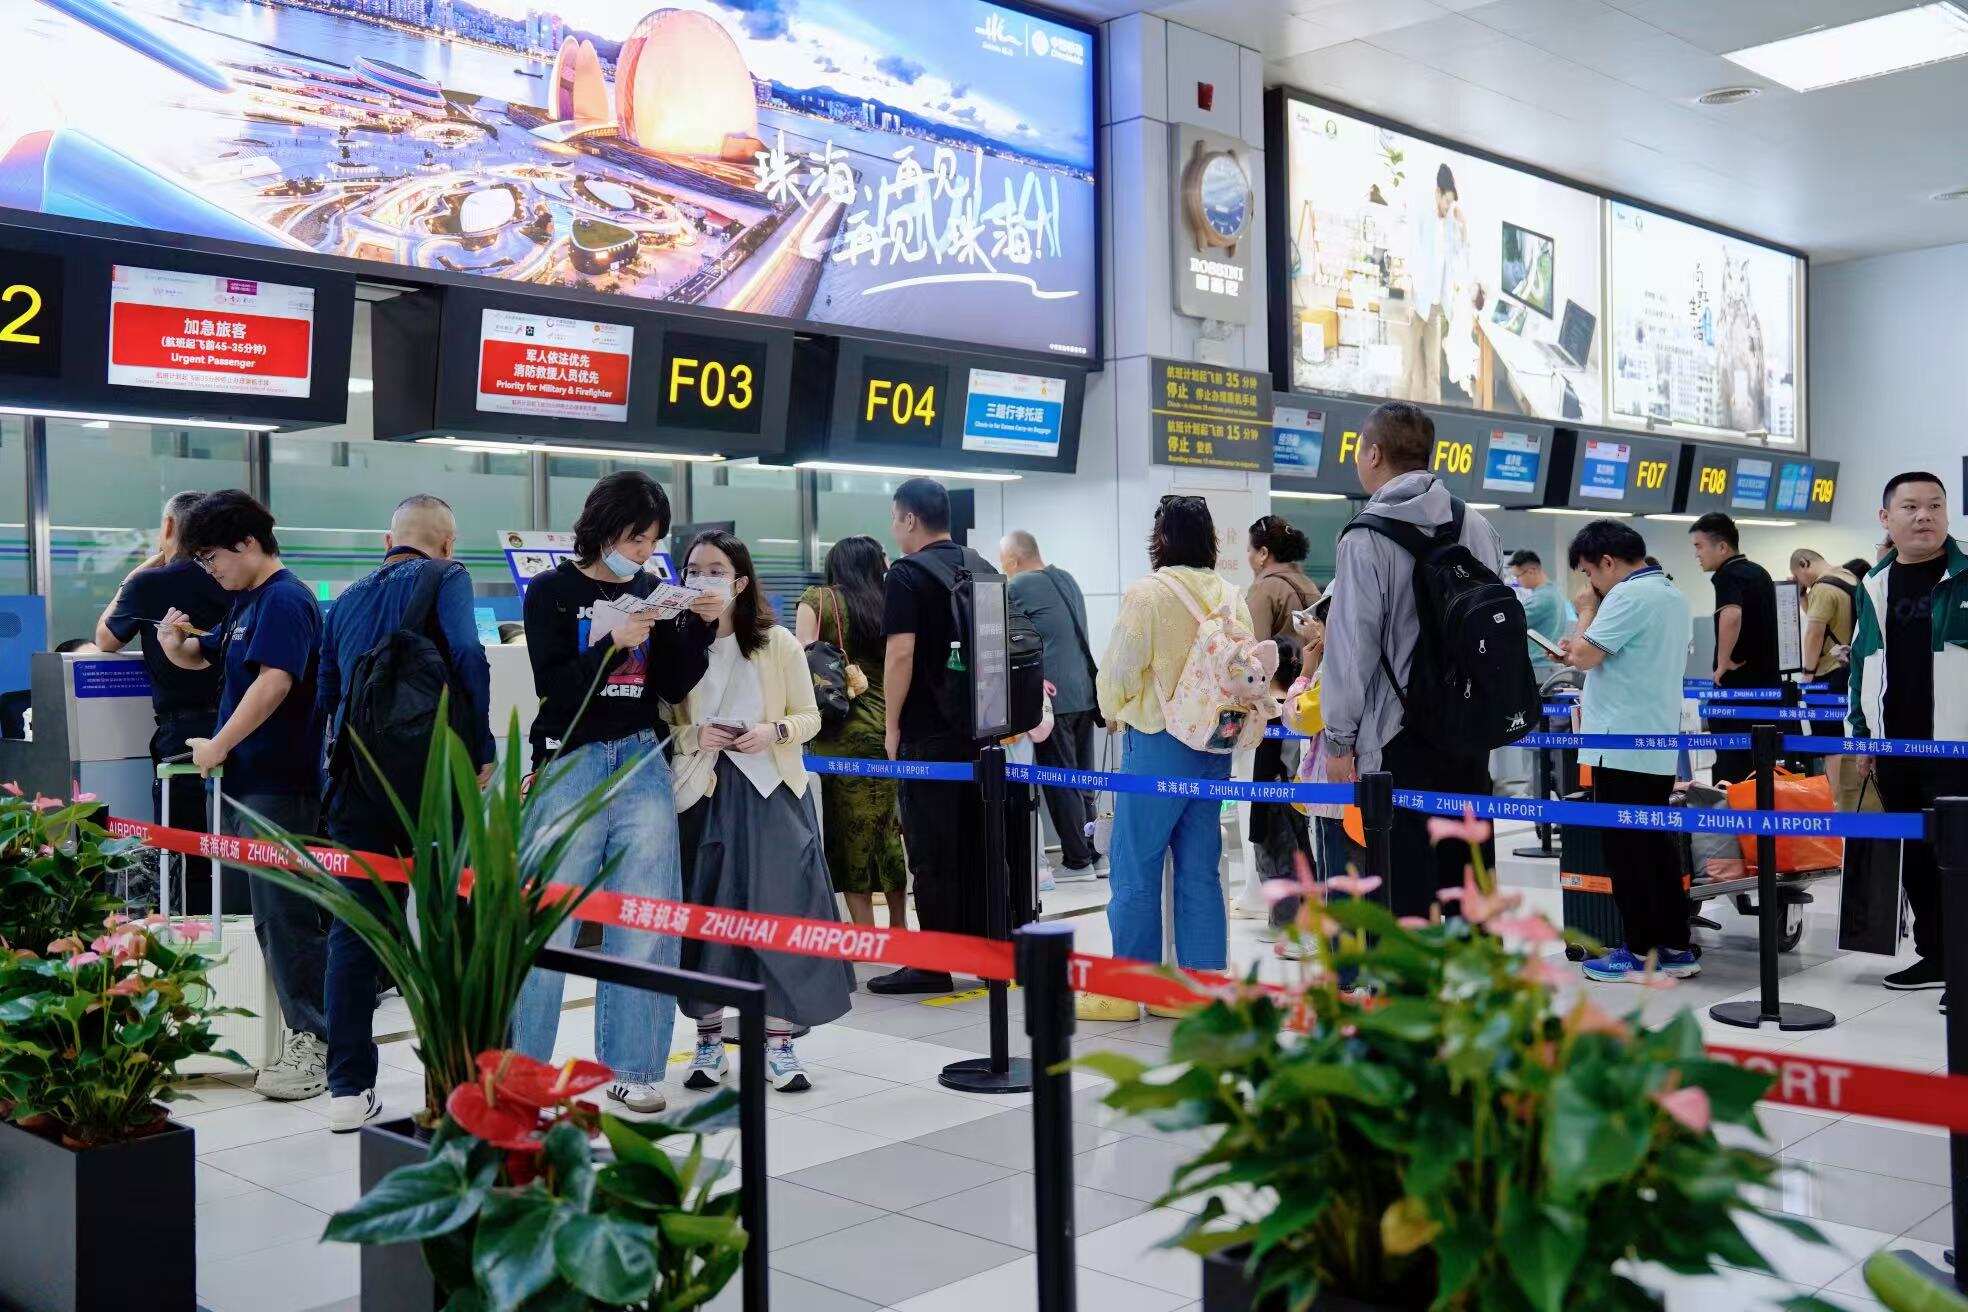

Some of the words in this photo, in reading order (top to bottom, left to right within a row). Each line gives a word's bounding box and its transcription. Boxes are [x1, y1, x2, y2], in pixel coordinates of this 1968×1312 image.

[184, 318, 247, 339] 加急旅客
[171, 352, 205, 366] Urgent
[207, 355, 256, 369] Passenger
[526, 348, 591, 367] 军人依法优先
[514, 363, 600, 384] 消防救援人员优先
[1225, 372, 1240, 388] 35
[496, 380, 525, 392] Priority
[526, 382, 538, 392] for
[539, 383, 567, 396] Military
[568, 386, 575, 395] &
[575, 387, 613, 399] Firefighter
[669, 357, 753, 410] F03
[1167, 381, 1189, 399] 停止
[866, 379, 936, 426] F04
[1227, 424, 1240, 441] 15
[1168, 436, 1190, 453] 停止
[1433, 440, 1473, 474] F06
[1636, 460, 1669, 490] F07
[1700, 467, 1728, 494] F08
[1812, 478, 1835, 503] F09
[1702, 708, 1736, 716] AIRPORT
[1780, 710, 1816, 719] 珠海机场
[1545, 736, 1583, 746] AIRPORT
[1634, 737, 1679, 748] 珠海机场
[1688, 738, 1723, 747] ZHUHAI
[1843, 741, 1893, 753] 珠海机场
[1904, 743, 1945, 754] ZHUHAI
[827, 760, 860, 773] 珠海机场
[866, 762, 893, 774] ZHUHAI
[897, 764, 930, 775] AIRPORT
[1037, 770, 1067, 783] ZHUHAI
[1071, 773, 1109, 787] AIRPORT
[1157, 780, 1201, 796] 珠海机场
[1209, 784, 1246, 798] ZHUHAI
[1250, 786, 1296, 799] AIRPORT
[1487, 801, 1544, 817] AIRPORT
[1617, 809, 1683, 828] 珠海机场
[1697, 814, 1752, 830] ZHUHAI
[1762, 816, 1832, 832] AIRPORT
[200, 836, 240, 860] 珠海机场
[619, 899, 690, 934] 珠海机场
[700, 909, 778, 944] ZHUHAI
[786, 921, 890, 959] AIRPORT
